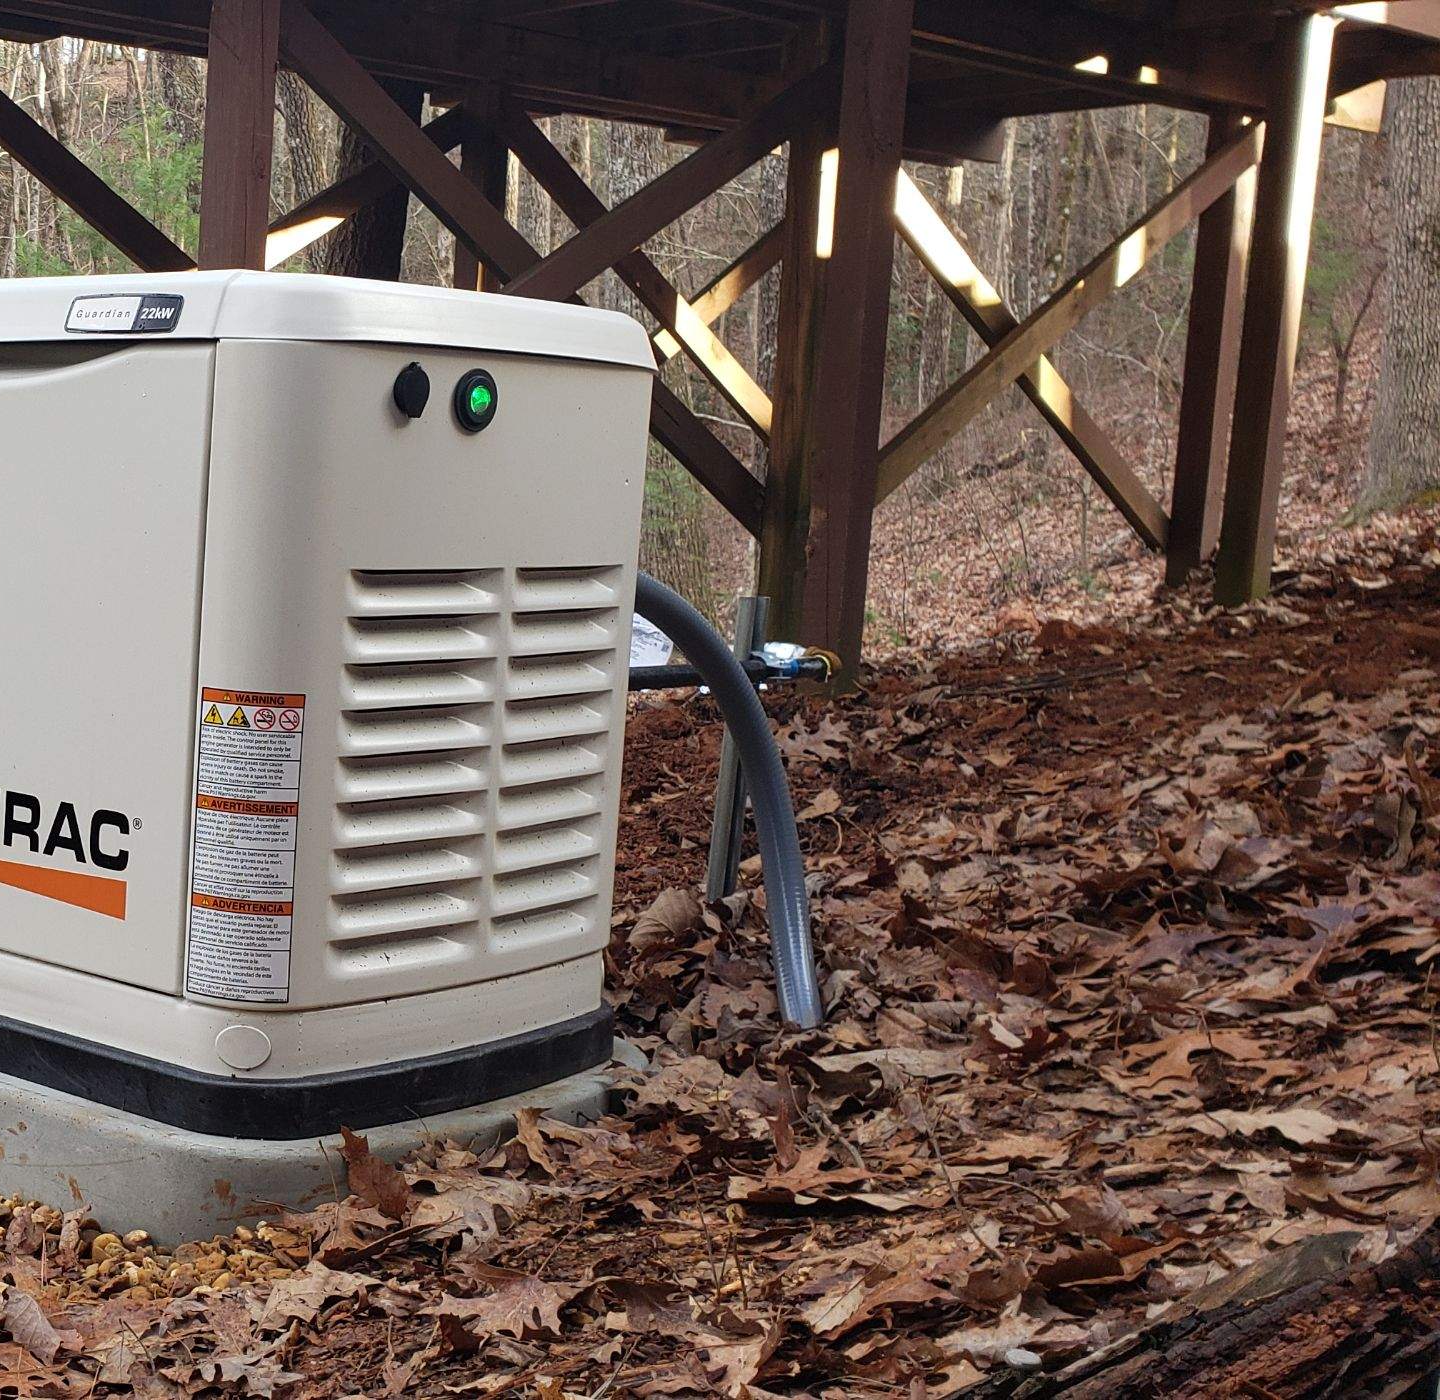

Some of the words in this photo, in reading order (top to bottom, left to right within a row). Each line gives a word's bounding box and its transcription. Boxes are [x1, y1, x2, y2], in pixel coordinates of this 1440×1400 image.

[76, 309, 131, 319] Guardian
[140, 307, 175, 319] 22kW
[235, 694, 285, 705] WARNING
[211, 799, 295, 814] AVERTISSEMENT
[212, 898, 284, 913] ADVERTENCIA
